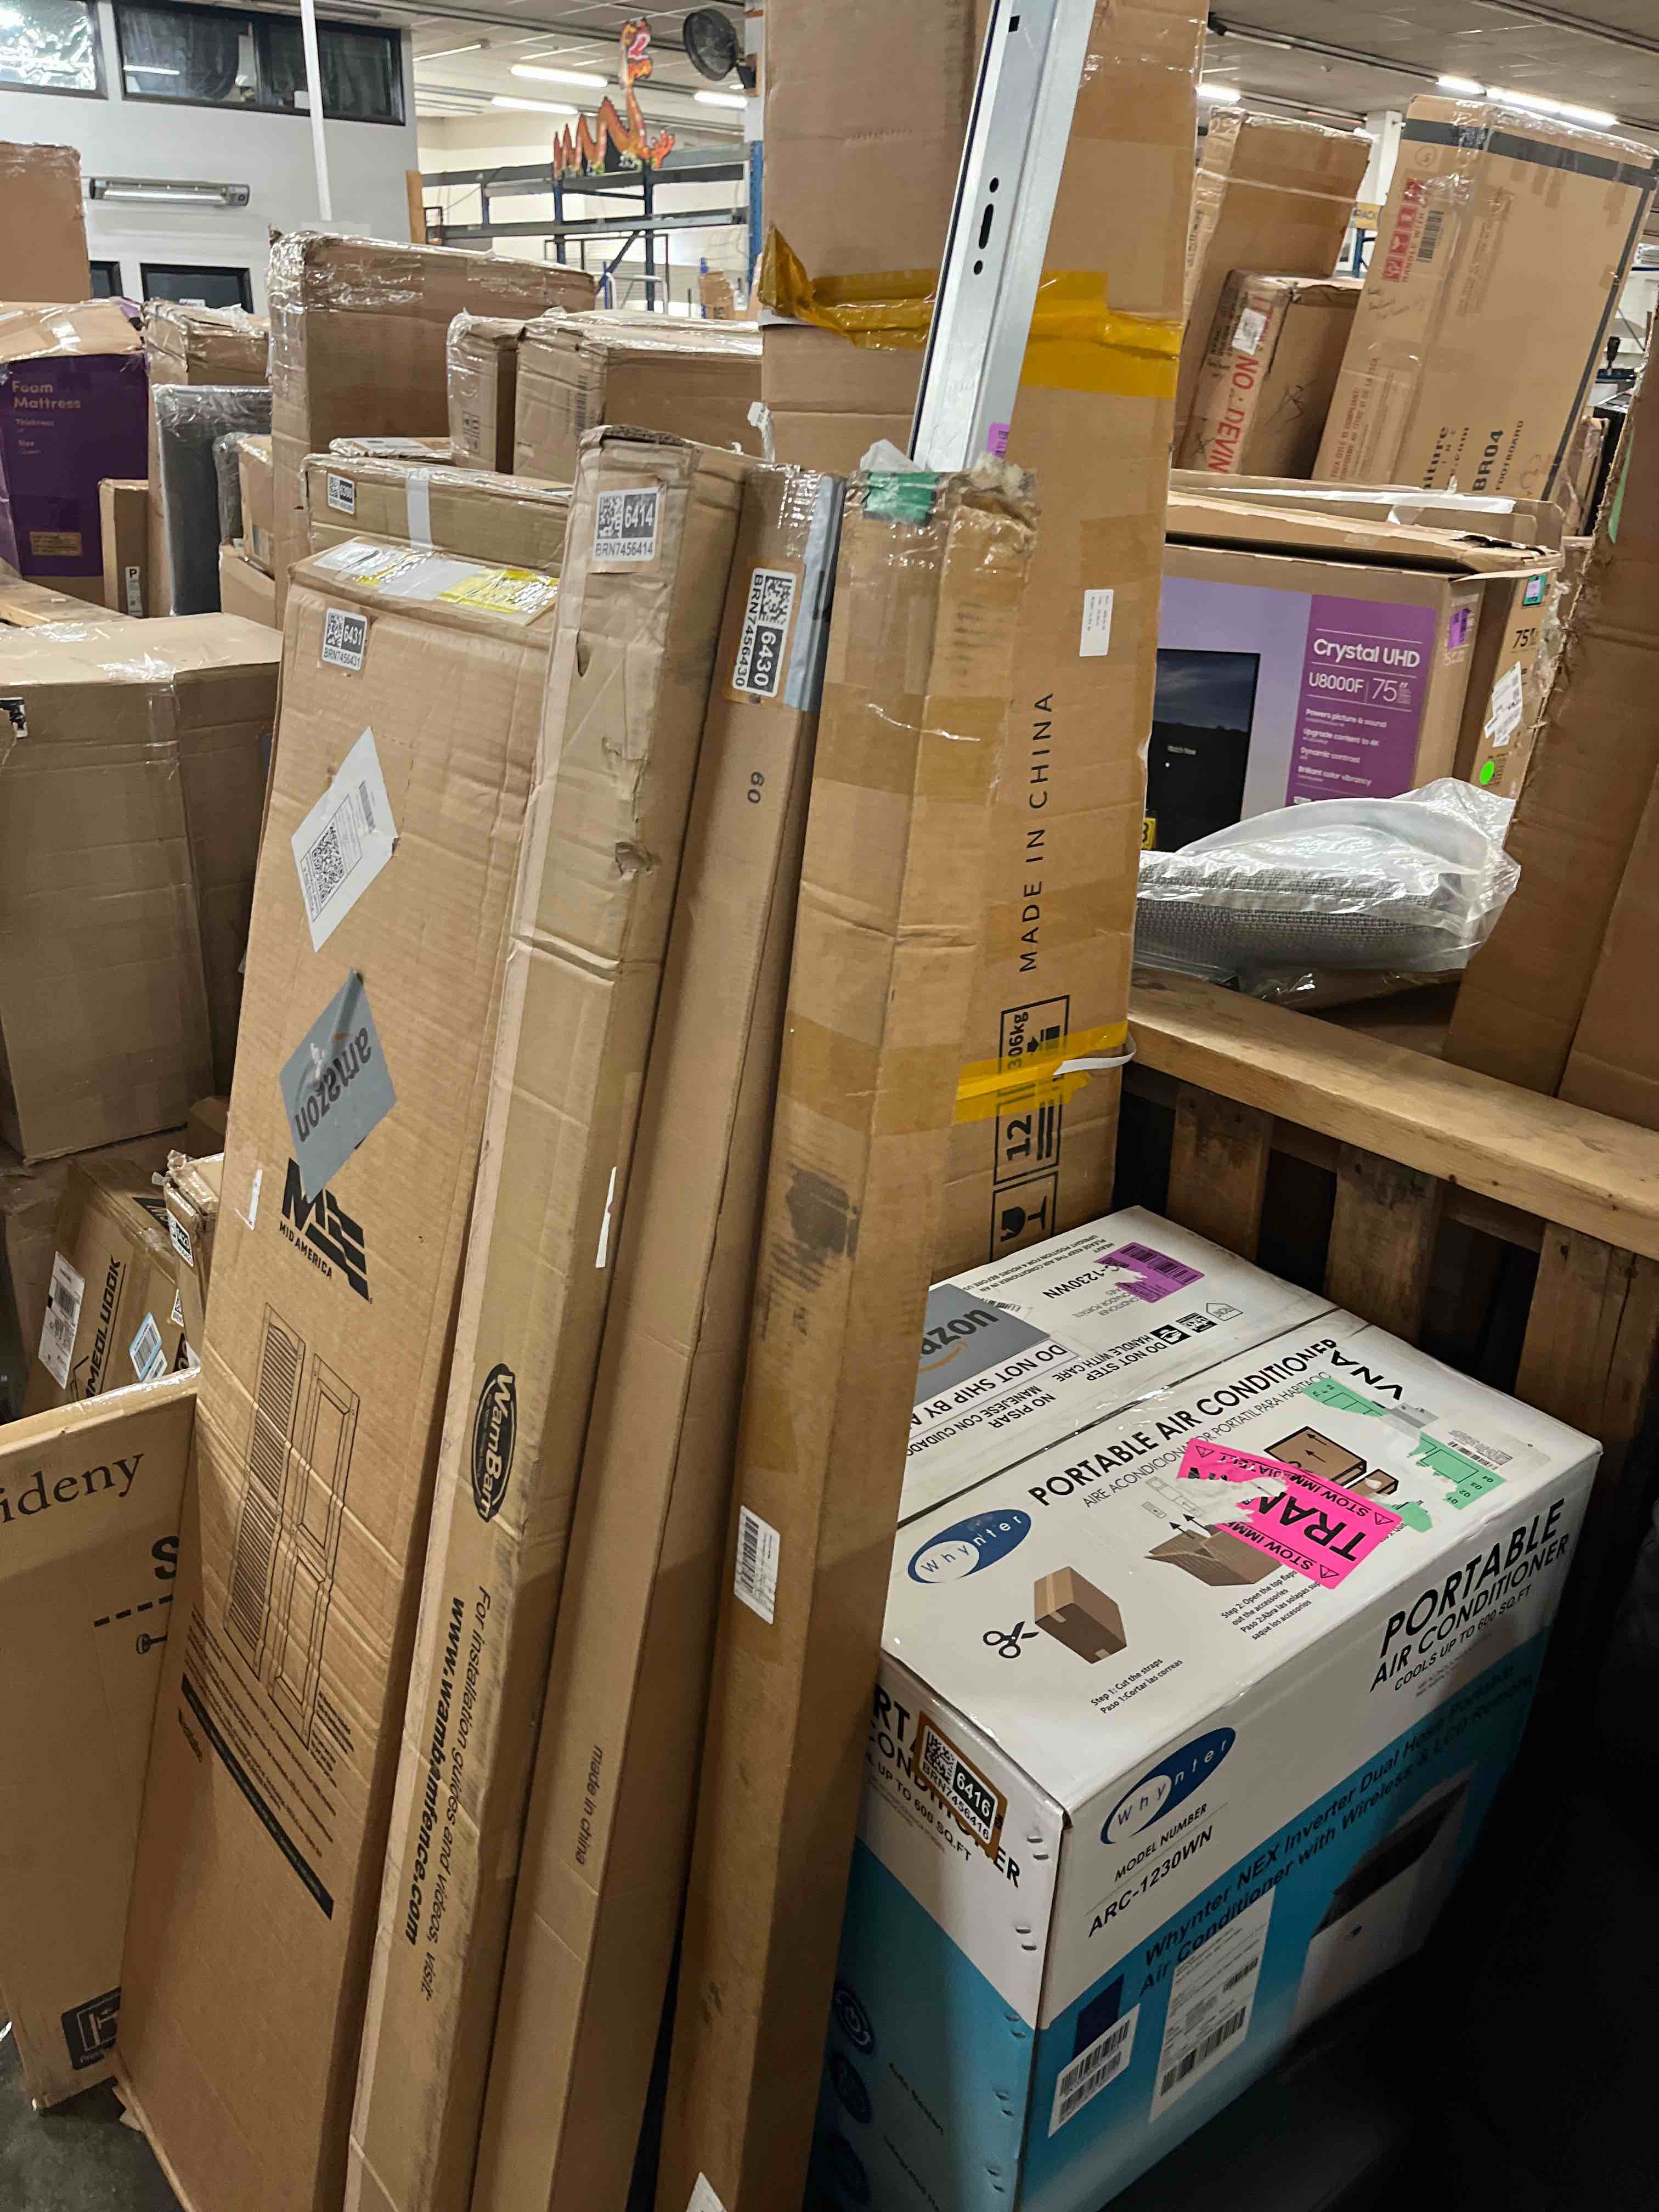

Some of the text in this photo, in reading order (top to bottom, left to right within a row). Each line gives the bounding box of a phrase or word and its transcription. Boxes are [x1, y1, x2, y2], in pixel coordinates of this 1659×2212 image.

[12, 380, 53, 393] Foam
[13, 396, 81, 409] Mattress
[1471, 430, 1504, 492] BR04
[624, 503, 654, 529] 6414
[595, 542, 654, 557] BRN7456414
[343, 625, 362, 646] 6431
[735, 574, 764, 687] BRN7456430
[1313, 639, 1421, 668] Crystal UHD
[324, 647, 360, 668] BRN7456431
[753, 631, 777, 687] 6430
[1308, 672, 1365, 693] U8000F
[1018, 692, 1054, 973] MADE IN CHINA
[294, 1026, 372, 1143] amazon
[1006, 1114, 1032, 1161] 12
[279, 1220, 334, 1279] MID AMERICA
[921, 1309, 1000, 1355] azon
[924, 1344, 1067, 1419] DO NOT SHIP BY
[1051, 1334, 1155, 1383] HANDLE WITH CARE
[1086, 1341, 1168, 1382] DO NOT STEP
[953, 1414, 983, 1431] CON
[979, 1385, 1043, 1418] MANEJESE
[988, 1393, 1057, 1429] NO PISAR
[1028, 1337, 1339, 1506] PORTABLE AIR CONDITIONER
[0, 1452, 145, 1524] ideny
[1082, 1486, 1110, 1509] AIRE
[1320, 1490, 1369, 1517] STOW
[151, 1535, 180, 1579] S
[1263, 1541, 1314, 1571] STOW
[1380, 1498, 1565, 1659] PORTABLE
[1221, 1607, 1239, 1618] Step
[1242, 1592, 1262, 1605] Open
[1259, 1584, 1272, 1595] the
[1270, 1579, 1283, 1588] top
[1280, 1570, 1299, 1581] flaps
[1232, 1588, 1289, 1626] out the accessories
[1240, 1620, 1259, 1633] Paso
[1277, 1601, 1288, 1610] las
[1286, 1587, 1310, 1605] solapas
[1369, 1644, 1412, 1693] AIR
[1418, 1533, 1570, 1655] CONDITIONER
[1251, 1599, 1312, 1641] saque los accesorios
[1394, 1652, 1437, 1692] COOLS
[1440, 1638, 1457, 1658] UP
[1459, 1625, 1475, 1644] TO
[1477, 1610, 1497, 1631] 600
[1090, 1693, 1110, 1706] Step
[1115, 1679, 1131, 1690] Cut
[1127, 1672, 1142, 1682] the
[1141, 1658, 1164, 1674] straps
[1100, 1700, 1120, 1714] Paso
[1145, 1674, 1159, 1684] las
[1157, 1659, 1184, 1678] correas
[405, 1597, 465, 1945] www.wambamfence.com
[421, 1585, 491, 2002] For installation guides and videos, visit:
[877, 1761, 894, 1781] UP
[895, 1779, 912, 1802] TO
[913, 1798, 933, 1824] 600
[956, 1771, 991, 1818] 6416
[574, 1745, 603, 1865] made in china
[922, 1763, 990, 1841] BRN7456416
[1114, 1802, 1208, 1883] MODEL NUMBER
[1144, 1885, 1233, 1967] Whynter
[1236, 1842, 1280, 1889] NEX
[1284, 1787, 1356, 1854] Inverter
[1359, 1750, 1400, 1793] Dual
[1088, 1825, 1213, 1938] ARC-1230WN
[1138, 1764, 1414, 1998] Air Conditioner with Wireless
